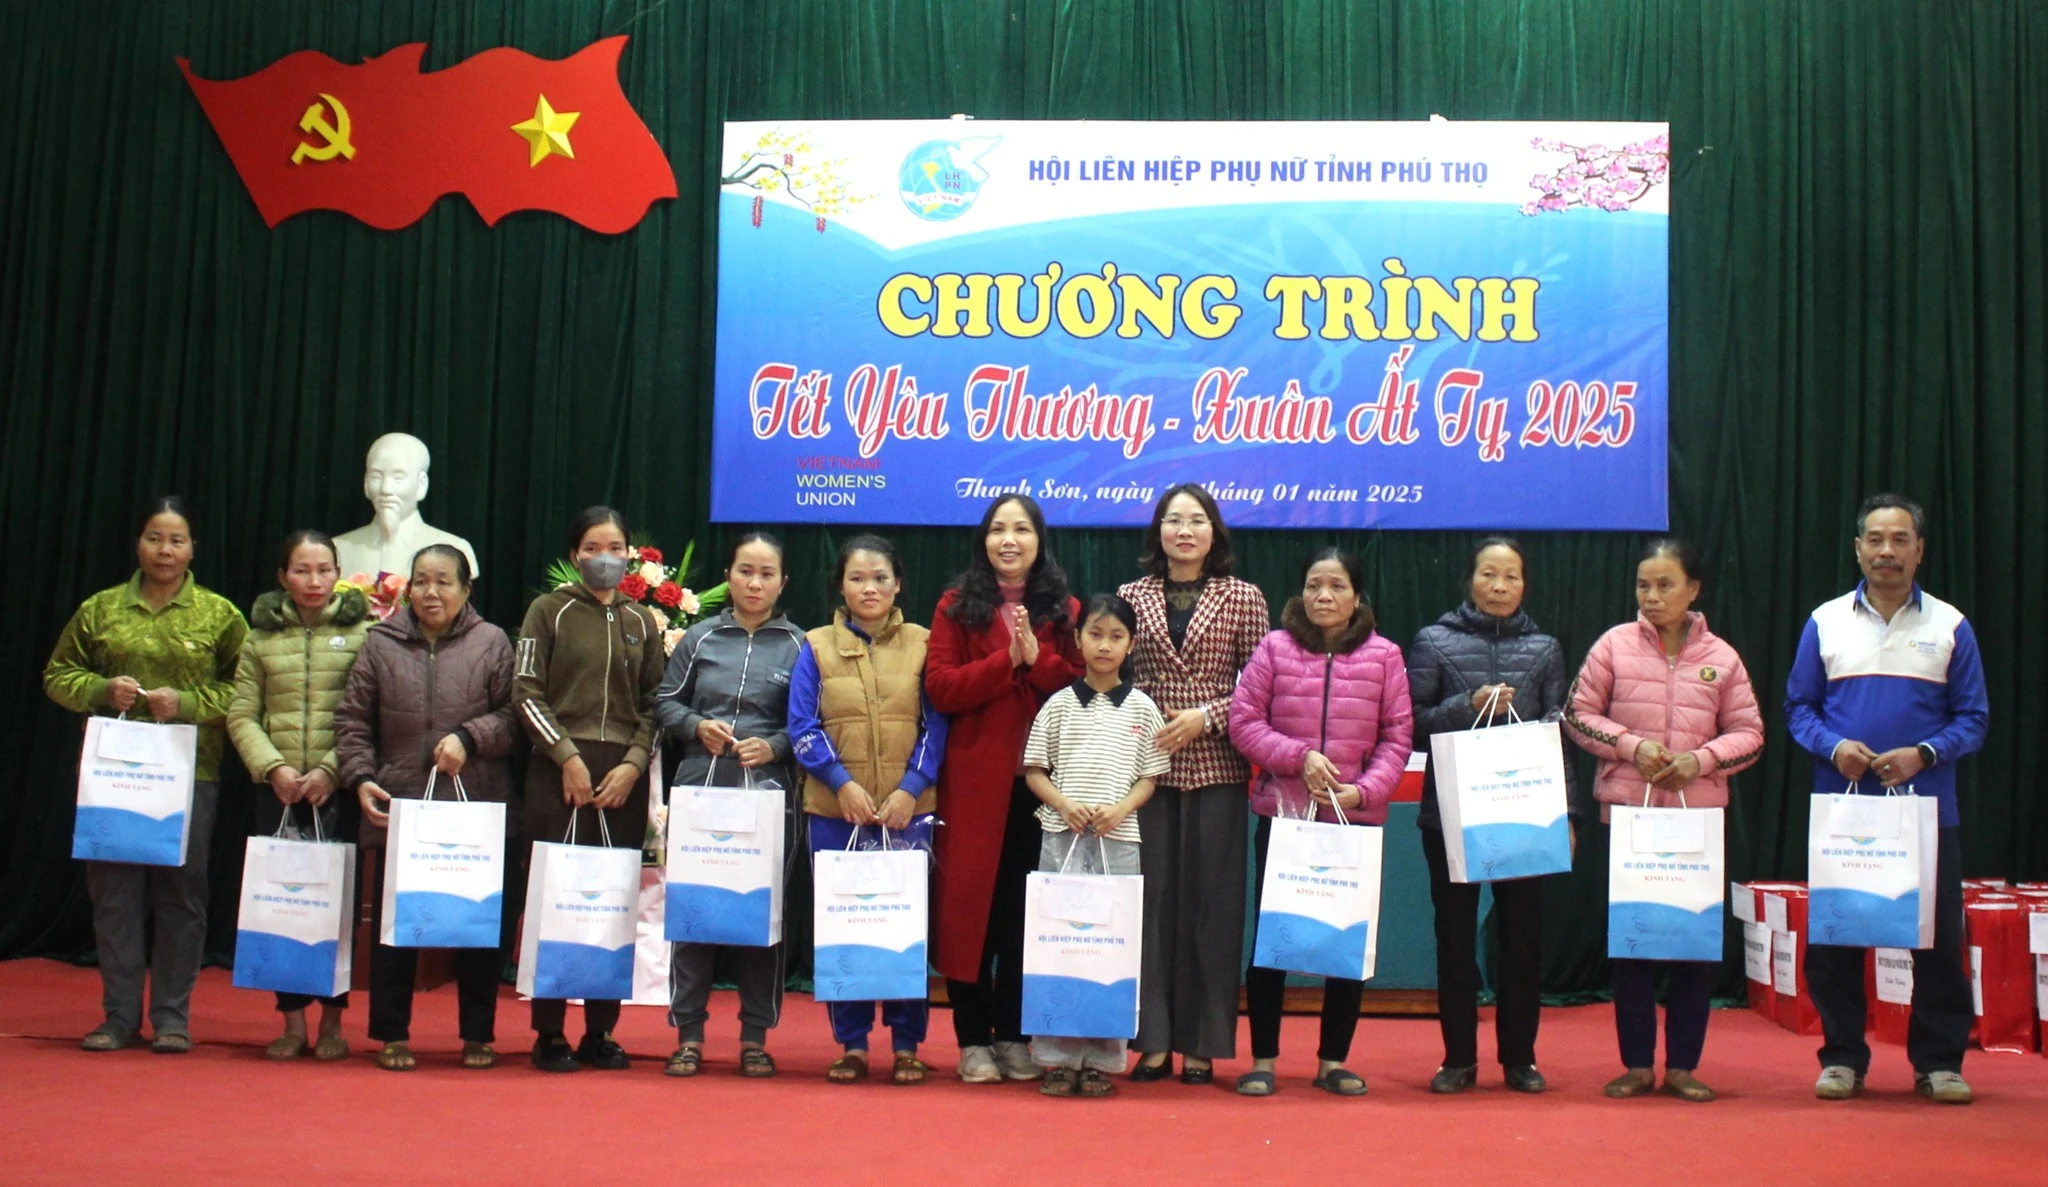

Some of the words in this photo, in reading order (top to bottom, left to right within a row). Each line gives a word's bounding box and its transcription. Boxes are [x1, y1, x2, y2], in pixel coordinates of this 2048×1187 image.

[1029, 154, 1070, 186] HỘI
[1079, 154, 1135, 182] LIÊN
[1144, 154, 1202, 187] HIỆP
[1210, 160, 1261, 187] PHỤ
[1270, 155, 1309, 183] NỮ
[1314, 153, 1372, 183] TỈNH
[1381, 156, 1432, 184] PHÚ
[1440, 161, 1488, 189] THỌ
[877, 260, 1243, 340] CHƯƠNG
[1263, 256, 1541, 343] TRÌNH
[749, 361, 833, 440] Tết
[843, 363, 950, 458] Yêu
[963, 363, 1156, 459] Thương
[1192, 366, 1337, 444] Xuân
[1345, 345, 1421, 446] Ất
[1434, 367, 1511, 462] Tỵ
[1519, 379, 1638, 451] 2025
[797, 456, 880, 470] VIETNAM
[796, 474, 886, 489] WOMEN'S
[1038, 478, 1088, 502] Sơn,
[1095, 481, 1155, 504] ngày
[1200, 480, 1265, 506] háng
[1272, 483, 1300, 502] 01
[1307, 483, 1359, 503] năm
[1365, 484, 1424, 503] 2025
[796, 492, 856, 506] UNION
